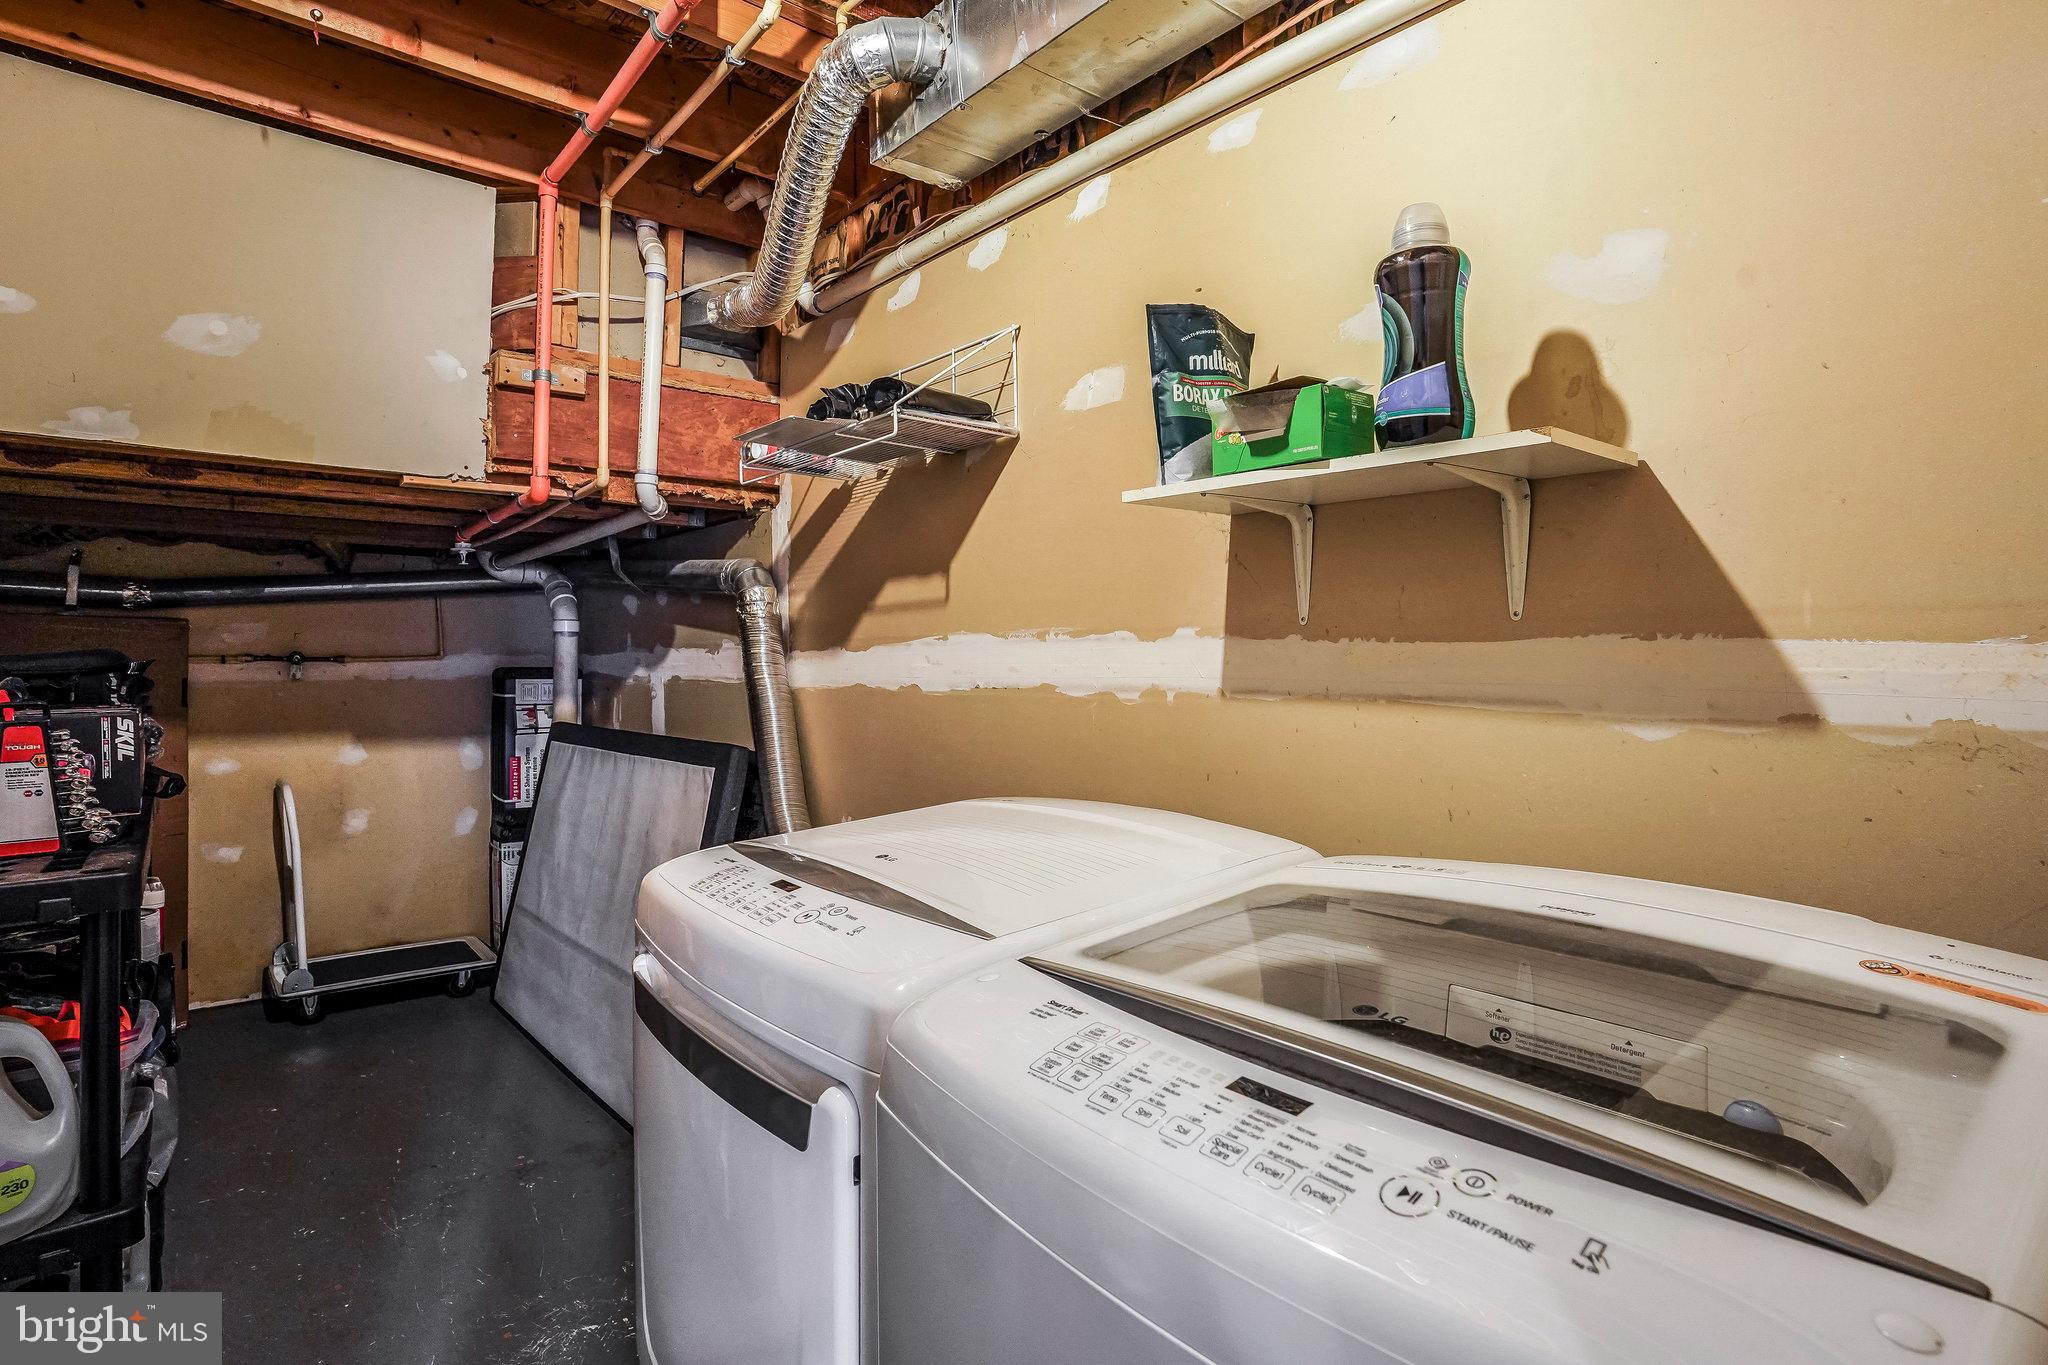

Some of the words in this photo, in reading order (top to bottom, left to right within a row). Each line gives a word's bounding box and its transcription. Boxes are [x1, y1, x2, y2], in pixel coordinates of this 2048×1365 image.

[1172, 384, 1221, 406] BORAX
[4, 742, 42, 751] TOUGH
[116, 716, 135, 762] SKIL
[1378, 1011, 1410, 1026] LG
[1484, 1011, 1511, 1023] Softener
[1610, 1043, 1646, 1058] Detergent
[1135, 1106, 1153, 1119] Spin
[1173, 1124, 1191, 1138] Soil
[1212, 1138, 1244, 1155] Special
[1277, 1141, 1294, 1152] Bulky
[1286, 1133, 1305, 1143] Heavy
[1305, 1141, 1320, 1151] Duty
[1210, 1147, 1230, 1160] Care
[1267, 1150, 1286, 1162] Bright
[1254, 1161, 1286, 1180] Cycle1
[1324, 1162, 1355, 1179] Delicates
[1334, 1153, 1355, 1166] Speed
[1354, 1163, 1374, 1174] Wash
[0, 1179, 30, 1197] 230
[1315, 1171, 1356, 1194] Downloaded
[1301, 1184, 1336, 1206] Cycle2
[1506, 1193, 1554, 1217] POWER
[1447, 1209, 1537, 1253] START/PAUSE
